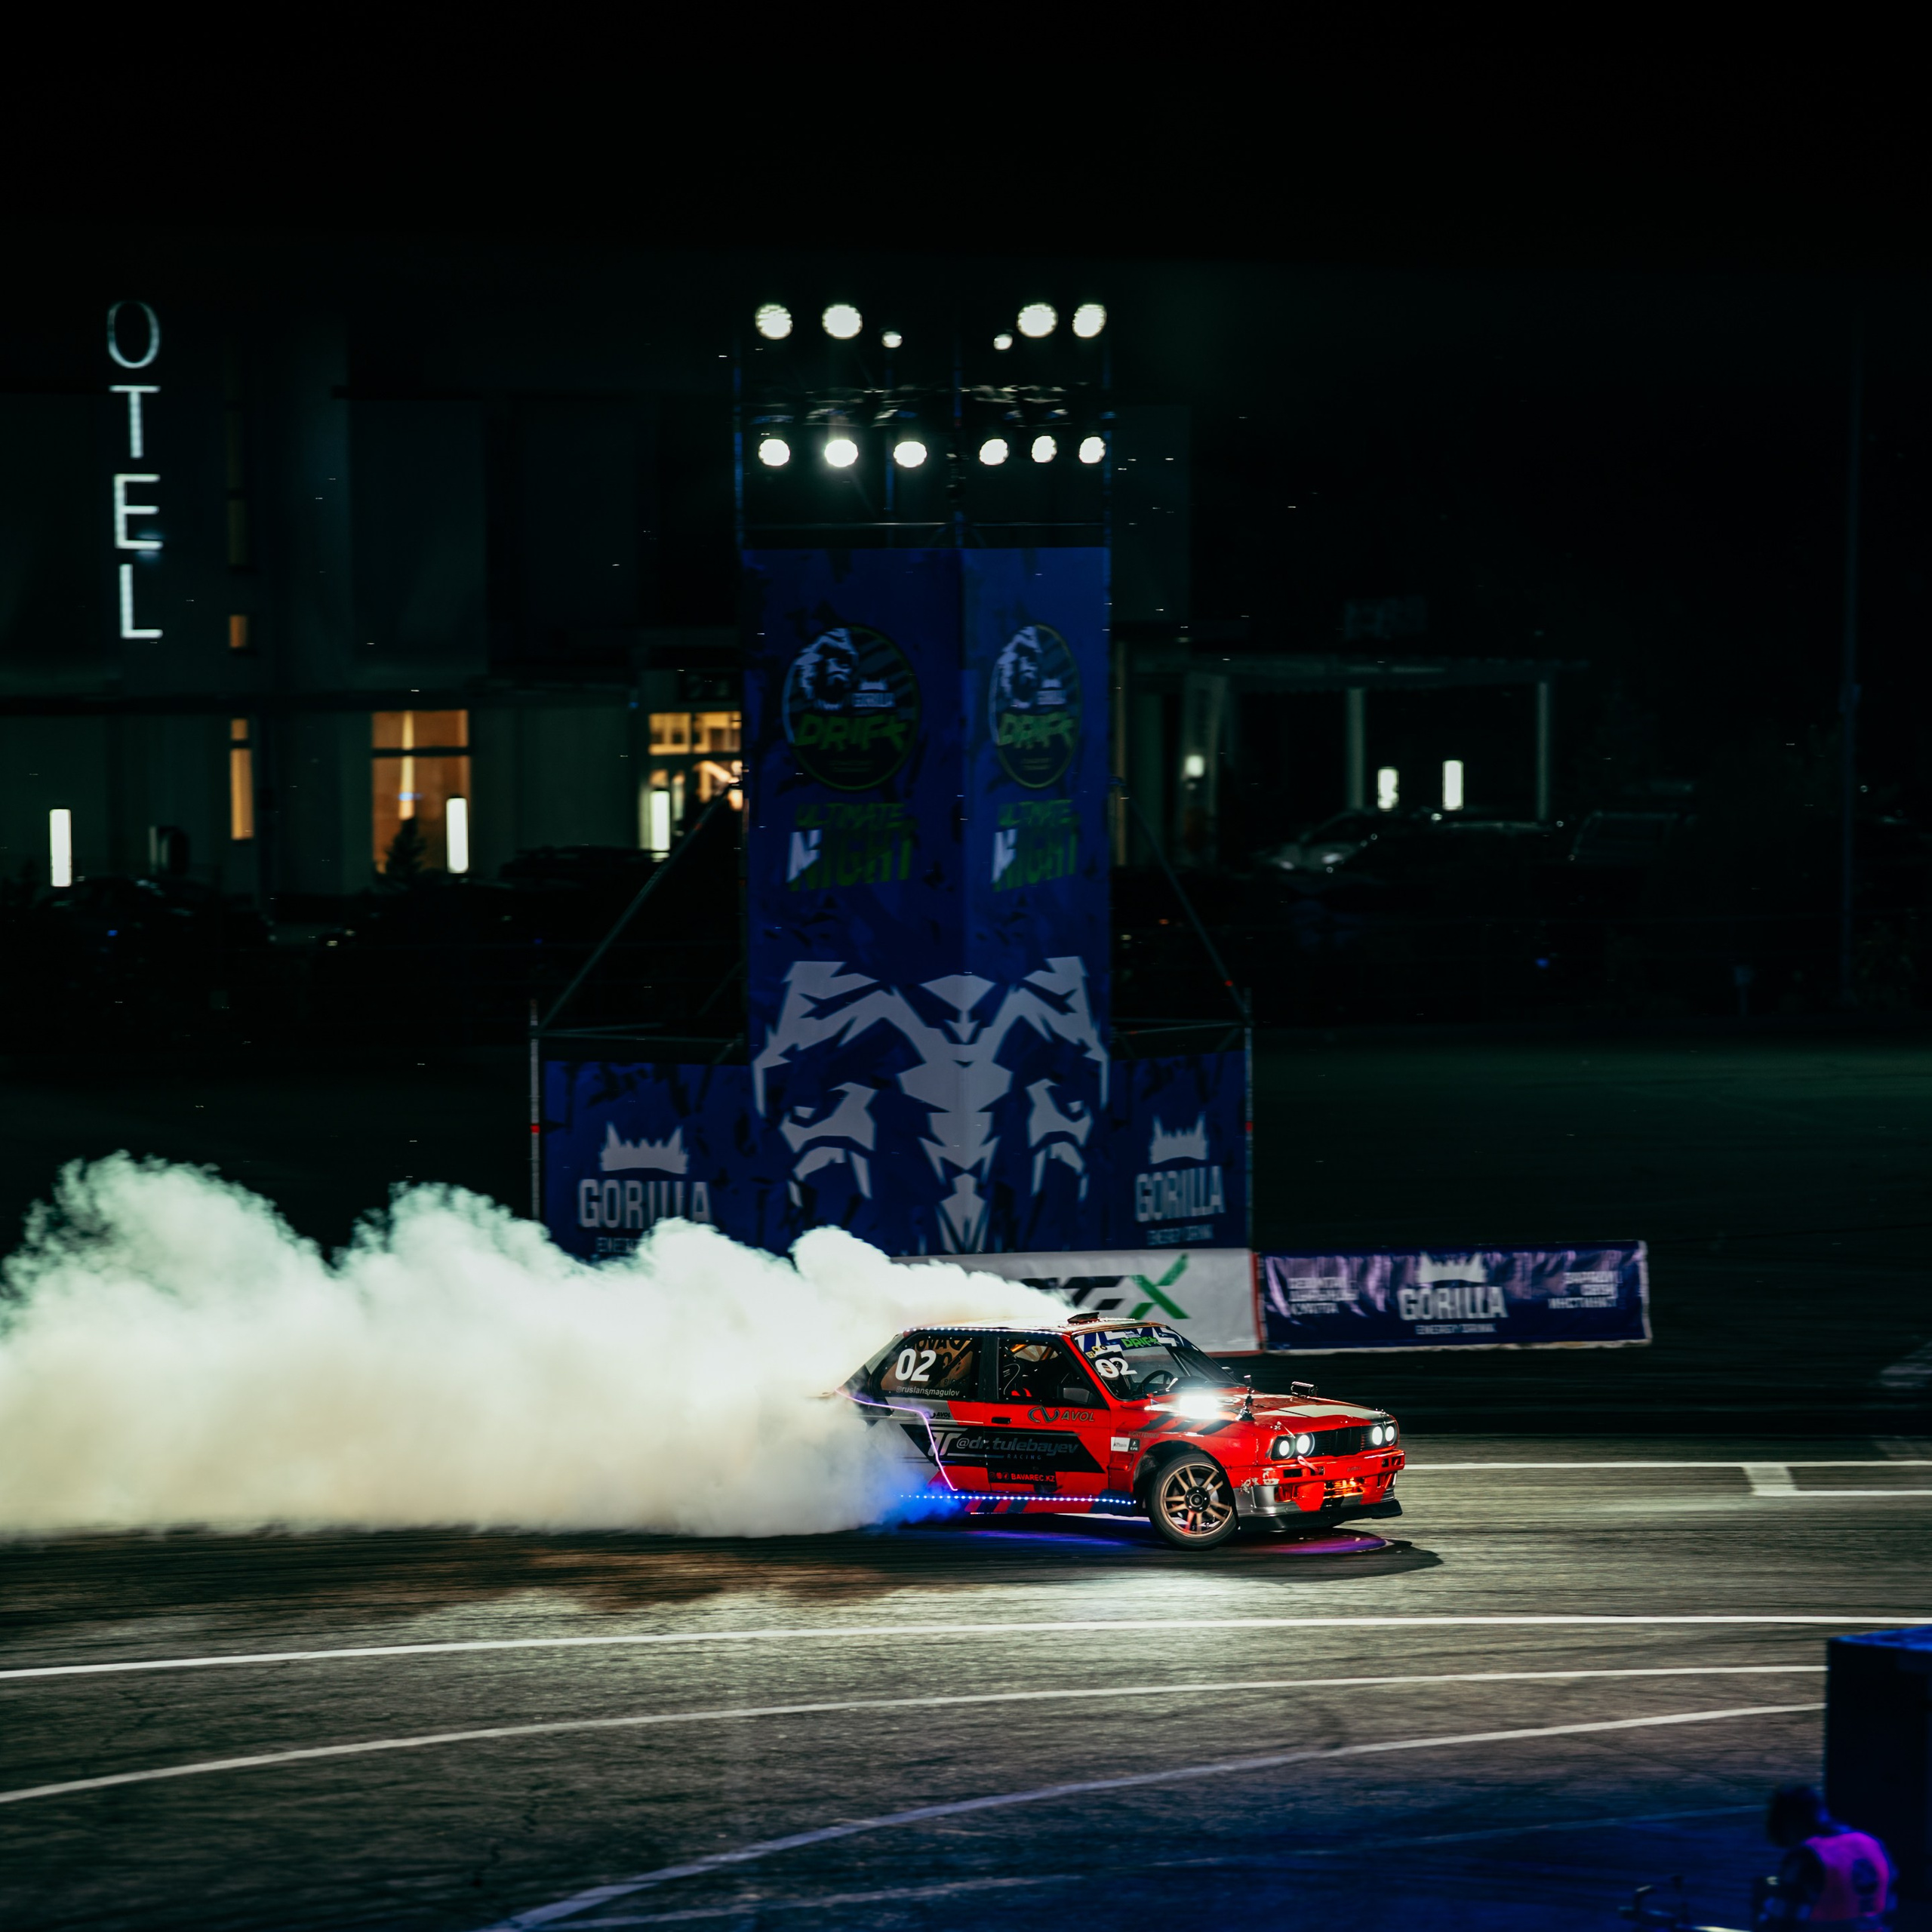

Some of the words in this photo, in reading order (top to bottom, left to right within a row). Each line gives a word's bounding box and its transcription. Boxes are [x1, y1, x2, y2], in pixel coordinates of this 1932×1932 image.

[794, 712, 908, 752] DRIFT
[1135, 1165, 1226, 1223] GORILLA
[1398, 1286, 1509, 1321] GORILLA
[895, 1348, 937, 1382] 02
[1095, 1357, 1138, 1379] 02
[1061, 1410, 1095, 1423] AVOL
[956, 1435, 1079, 1456] @dr.tulebayev
[1011, 1472, 1056, 1482] BAVAREC.KZ
